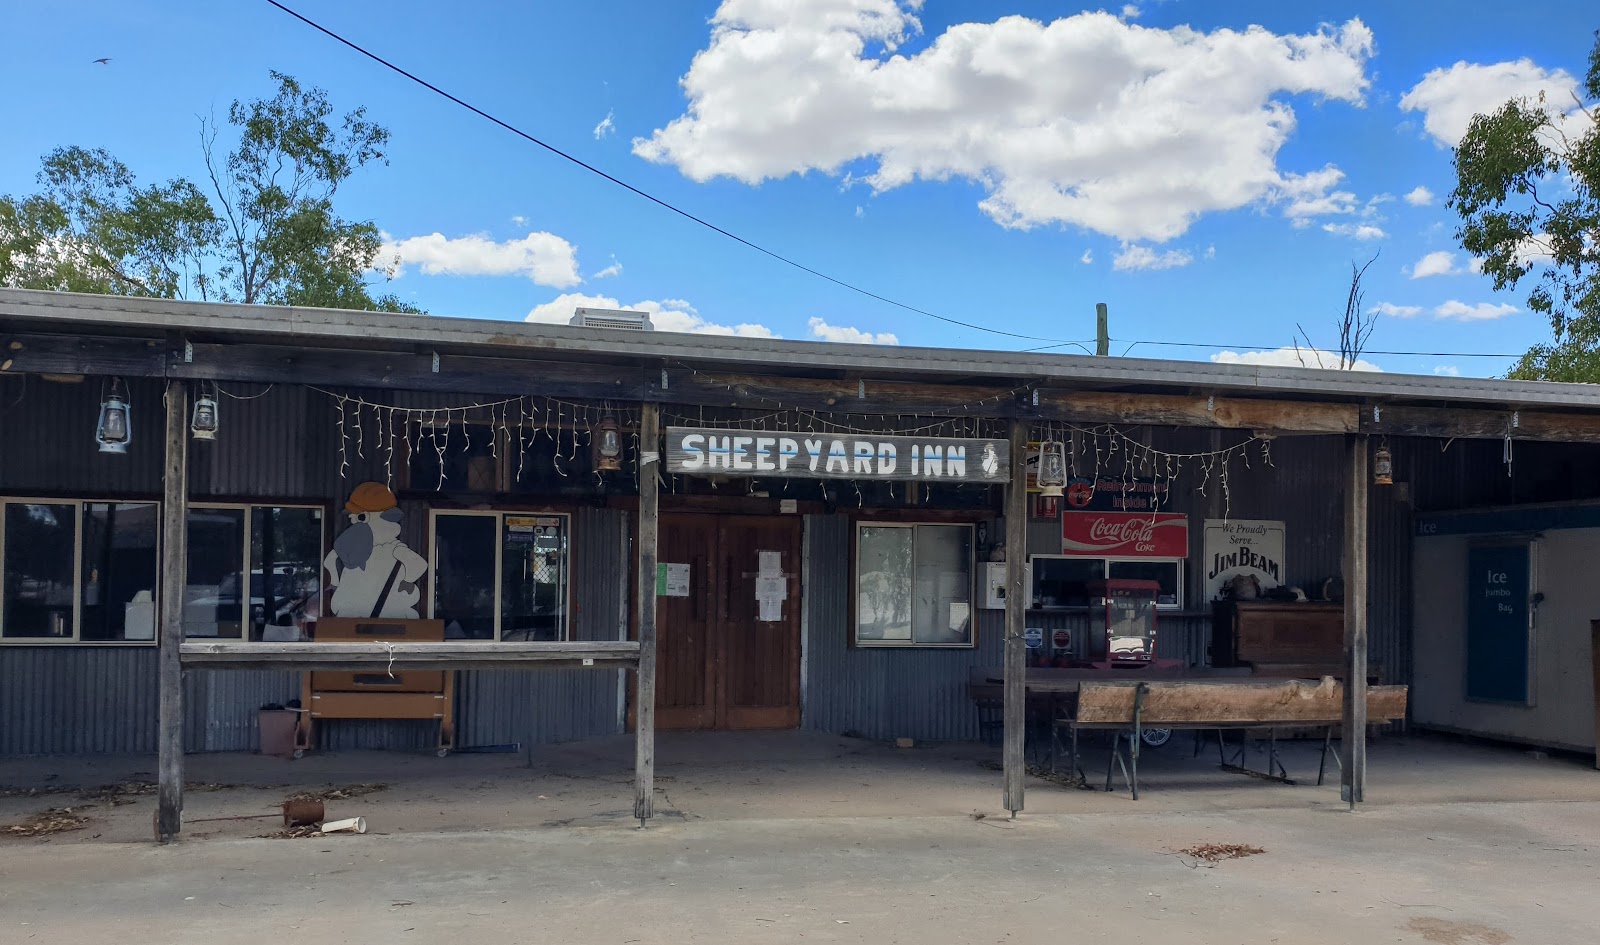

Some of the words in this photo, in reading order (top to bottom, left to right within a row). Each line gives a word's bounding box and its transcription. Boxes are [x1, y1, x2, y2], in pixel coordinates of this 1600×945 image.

[680, 434, 897, 475] SHEEPYARD
[910, 444, 966, 477] INN
[1112, 495, 1147, 508] Inside
[1090, 517, 1153, 542] Coca-Cola
[1222, 523, 1235, 533] We
[1235, 524, 1268, 536] Proudly
[1419, 520, 1437, 533] Ice
[1229, 534, 1259, 545] Serve...
[1135, 541, 1156, 552] Coke
[1208, 552, 1237, 580] JIM
[1238, 546, 1279, 582] BEAM
[1487, 569, 1507, 584] Ice
[1498, 602, 1513, 614] Bag
